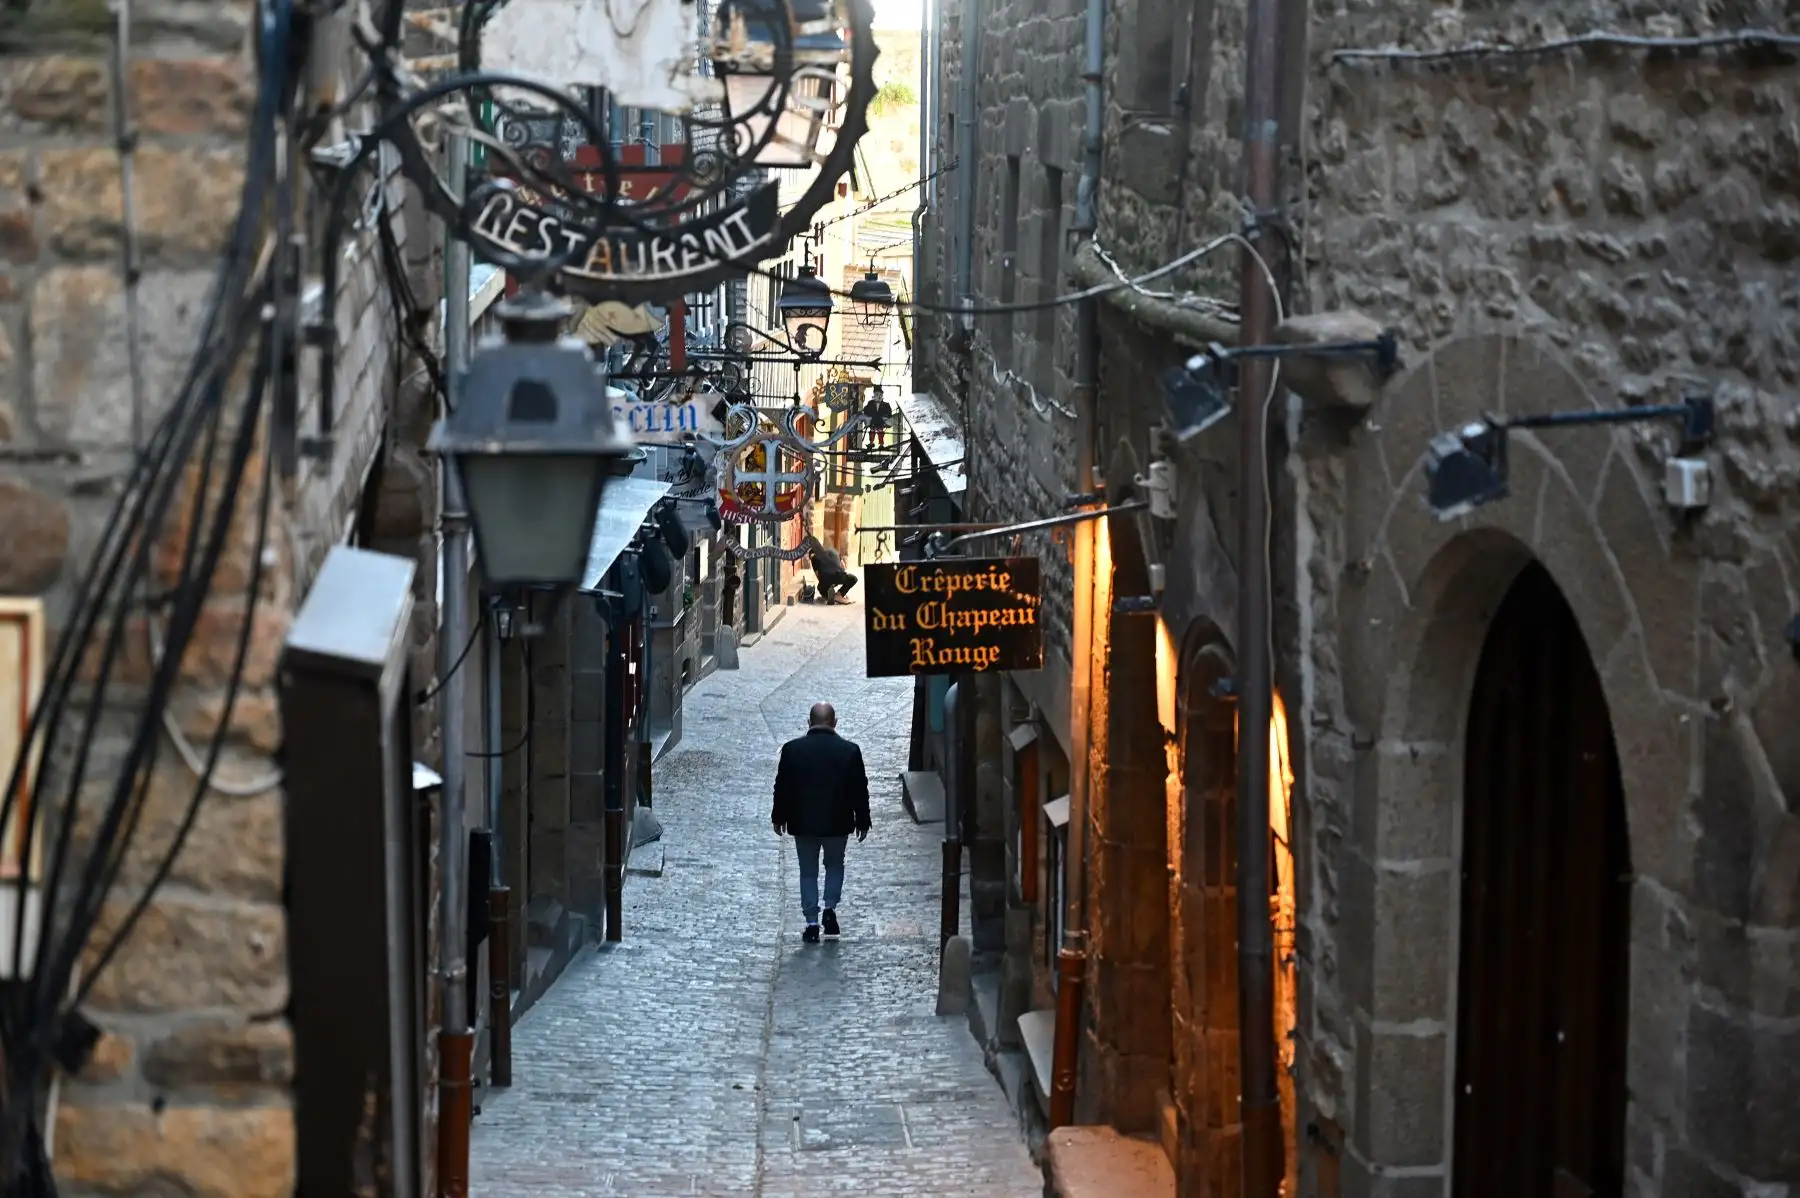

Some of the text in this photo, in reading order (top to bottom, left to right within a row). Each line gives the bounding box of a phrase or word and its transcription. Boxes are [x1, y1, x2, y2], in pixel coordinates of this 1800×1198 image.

[470, 191, 750, 276] RESTAURANT
[894, 565, 1011, 600] Crêperie
[872, 600, 1036, 636] du Chapeau
[909, 637, 1001, 672] Rouge
